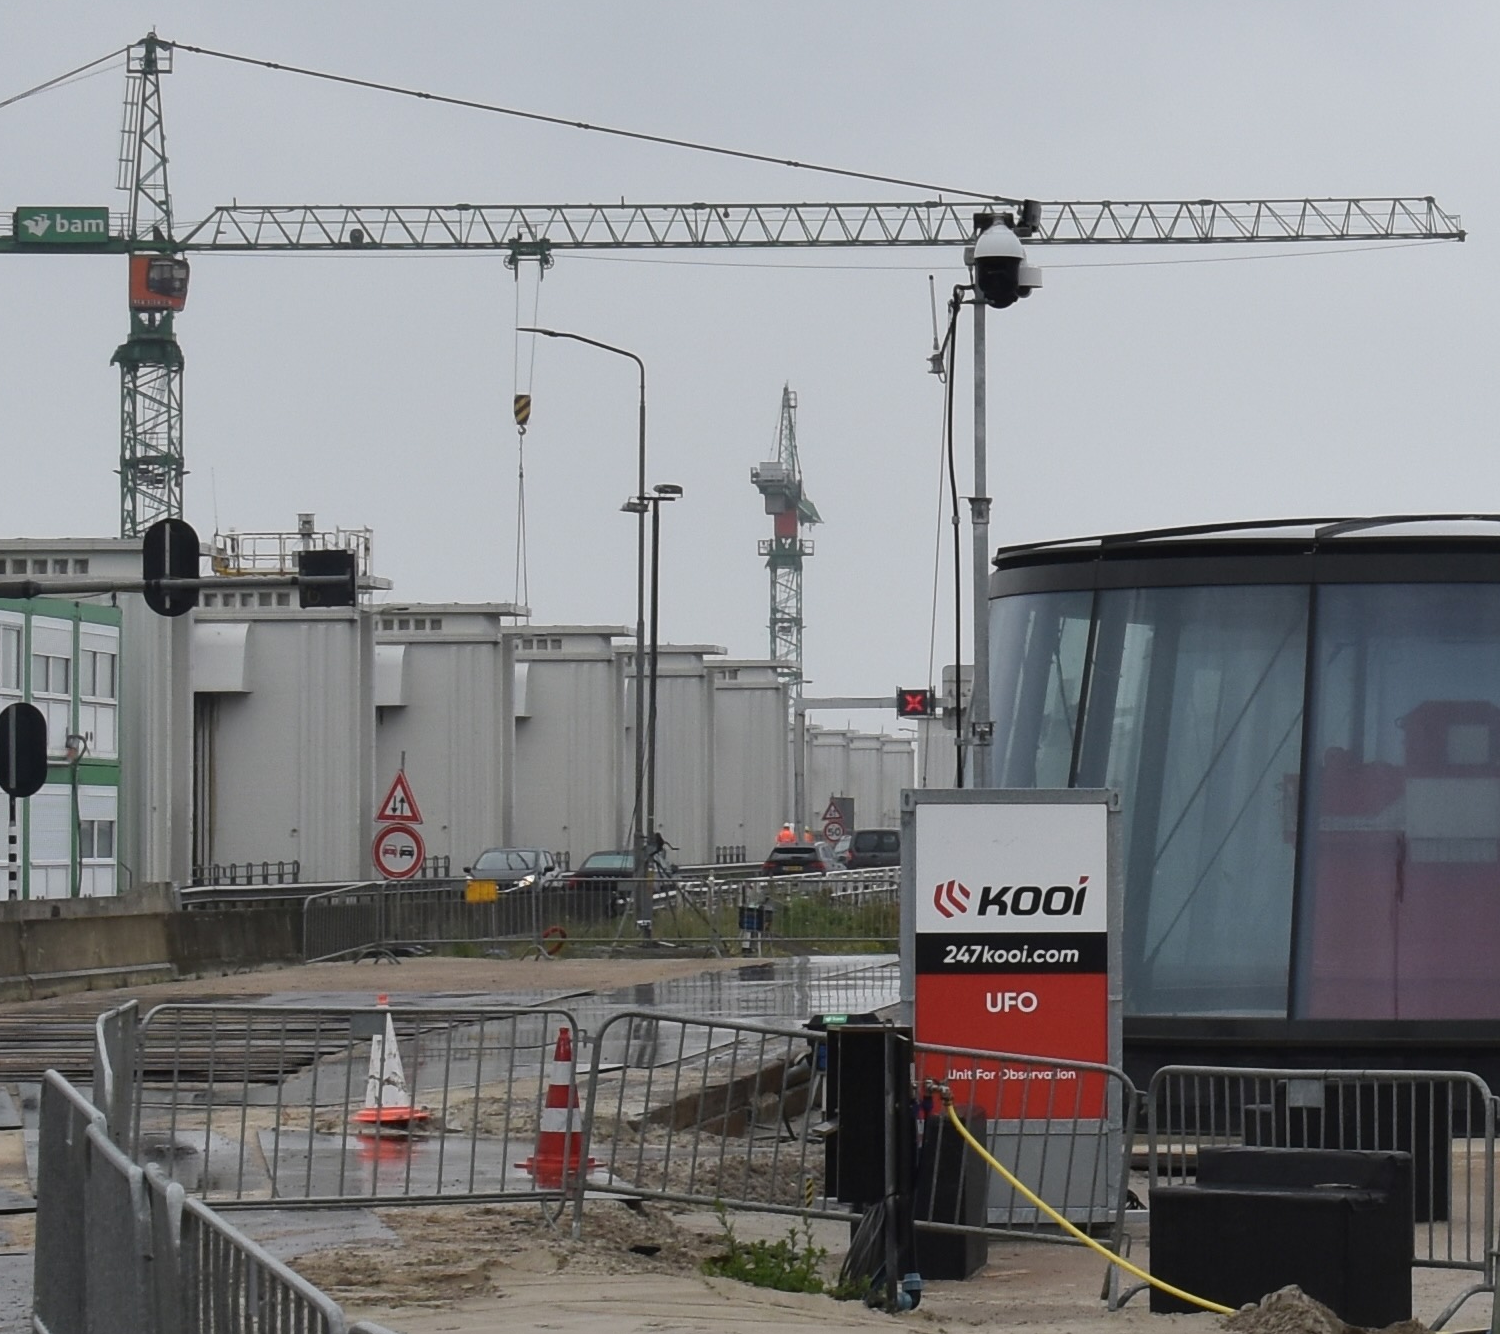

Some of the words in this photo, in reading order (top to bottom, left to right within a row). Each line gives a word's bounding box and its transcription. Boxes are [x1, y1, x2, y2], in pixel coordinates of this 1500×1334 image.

[55, 213, 105, 233] bam
[828, 828, 841, 836] 50
[943, 944, 1080, 964] 247kooi.com
[986, 991, 1039, 1013] UFO
[948, 1068, 972, 1080] Unit
[976, 1068, 996, 1080] For
